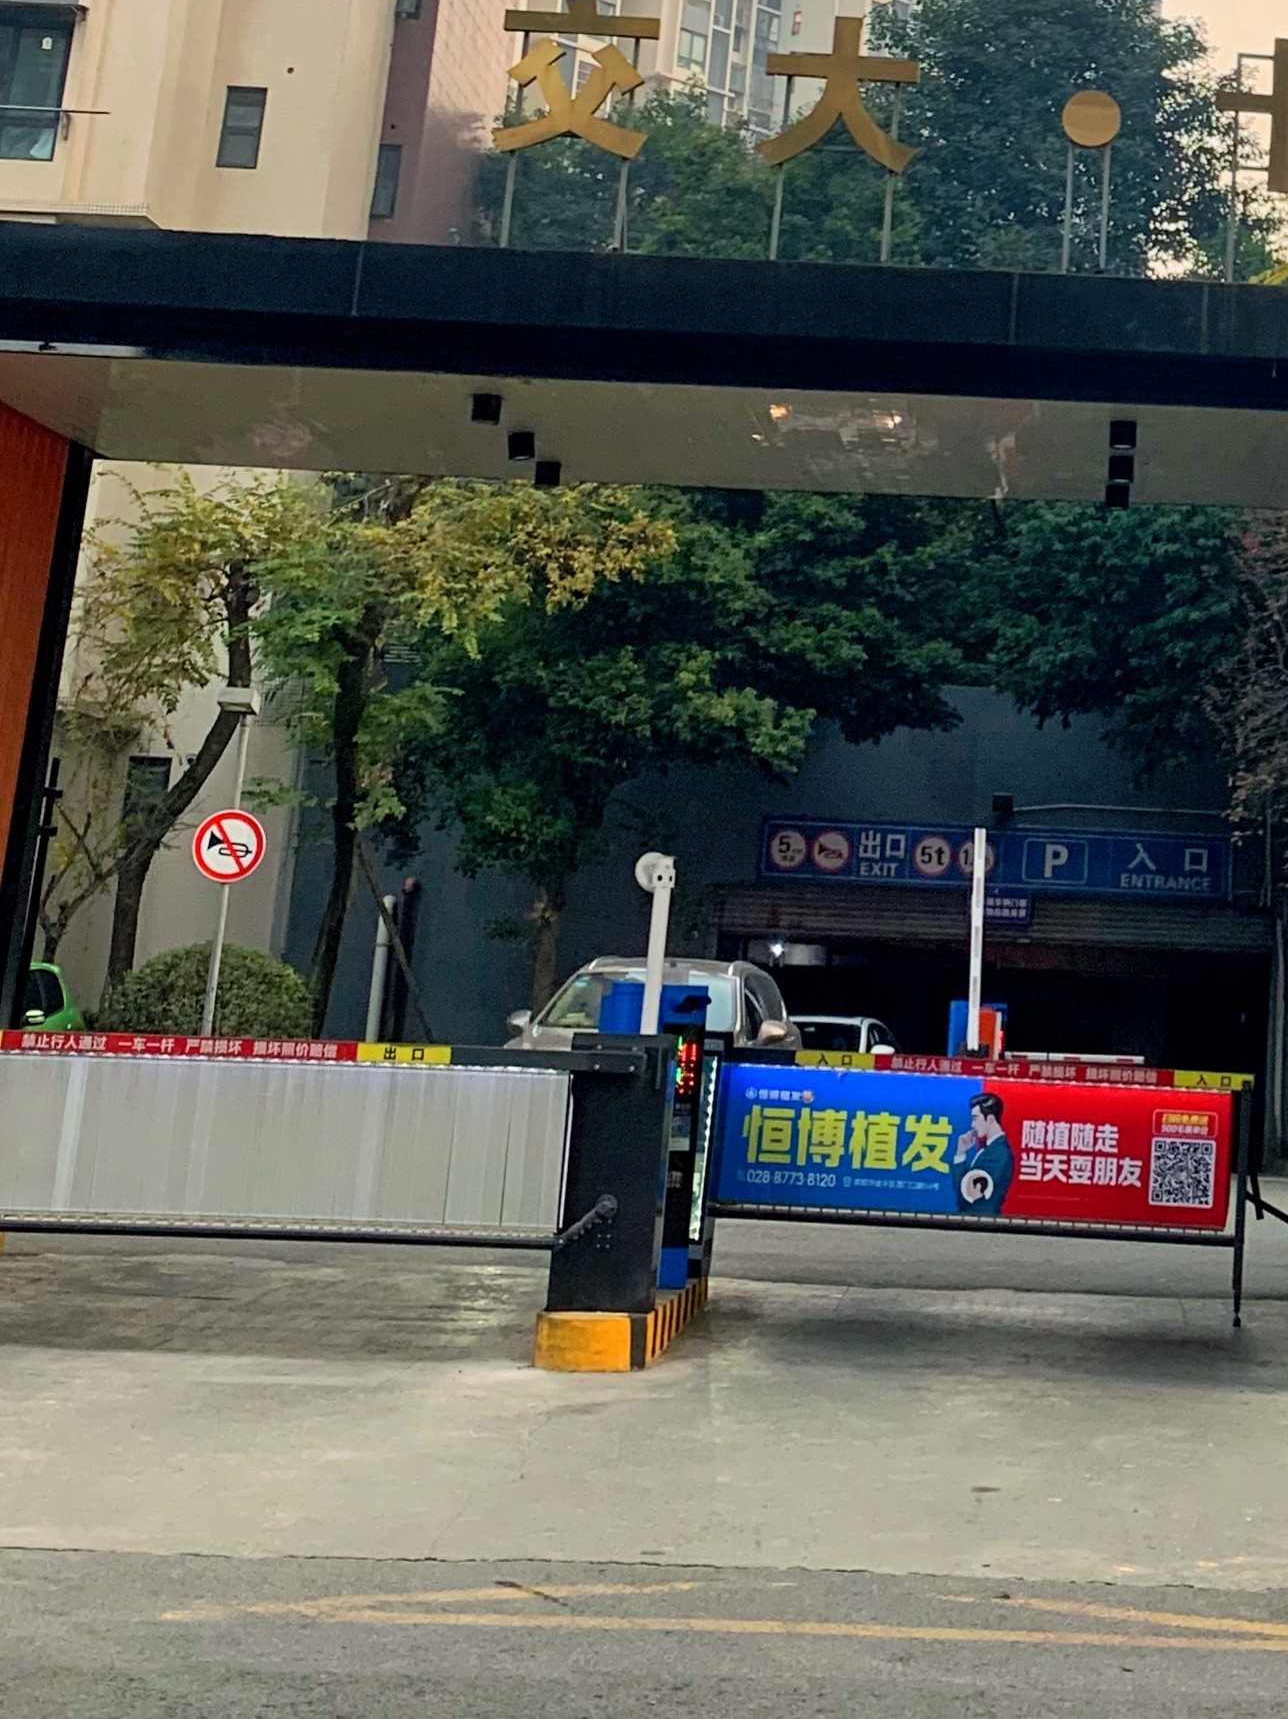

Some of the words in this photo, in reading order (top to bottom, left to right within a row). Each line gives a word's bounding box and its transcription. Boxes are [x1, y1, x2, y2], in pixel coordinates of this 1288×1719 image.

[858, 830, 907, 859] 出口
[920, 845, 945, 866] 5t
[1044, 843, 1069, 878] P
[1128, 843, 1208, 872] 入口
[859, 862, 899, 877] EXIT
[1119, 873, 1212, 891] ENTRANCE
[21, 1033, 107, 1051] 禁止行人通过
[118, 1037, 175, 1053] 一车一杆
[383, 1046, 425, 1062] 出口
[817, 1054, 853, 1066] 入口
[1196, 1075, 1232, 1088] 入口
[742, 1104, 953, 1174] 恒博植发
[1021, 1120, 1119, 1153] 随植随走
[1018, 1152, 1143, 1188] 当天耍朋友
